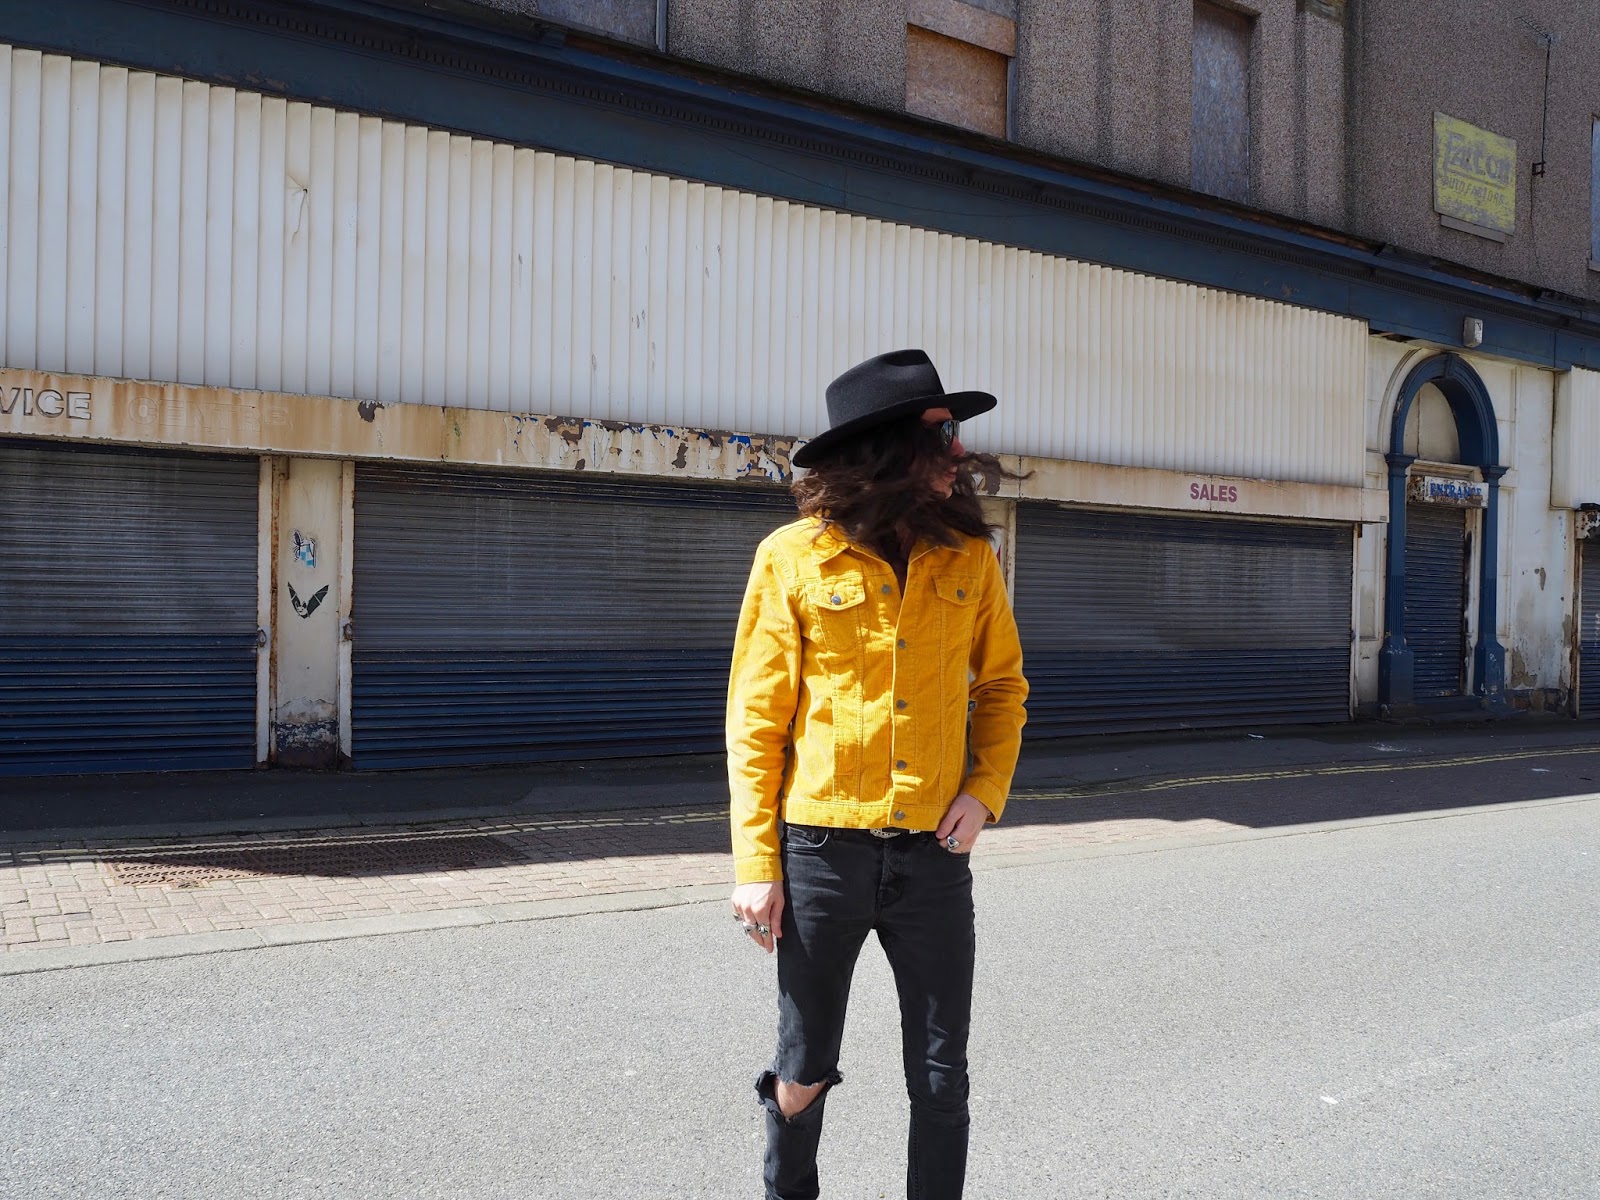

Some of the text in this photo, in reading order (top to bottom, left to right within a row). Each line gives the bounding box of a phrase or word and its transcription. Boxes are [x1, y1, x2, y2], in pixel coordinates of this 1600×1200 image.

[0, 386, 92, 420] VICE
[1190, 482, 1238, 503] SALES
[1430, 482, 1482, 499] ENTRANCE
